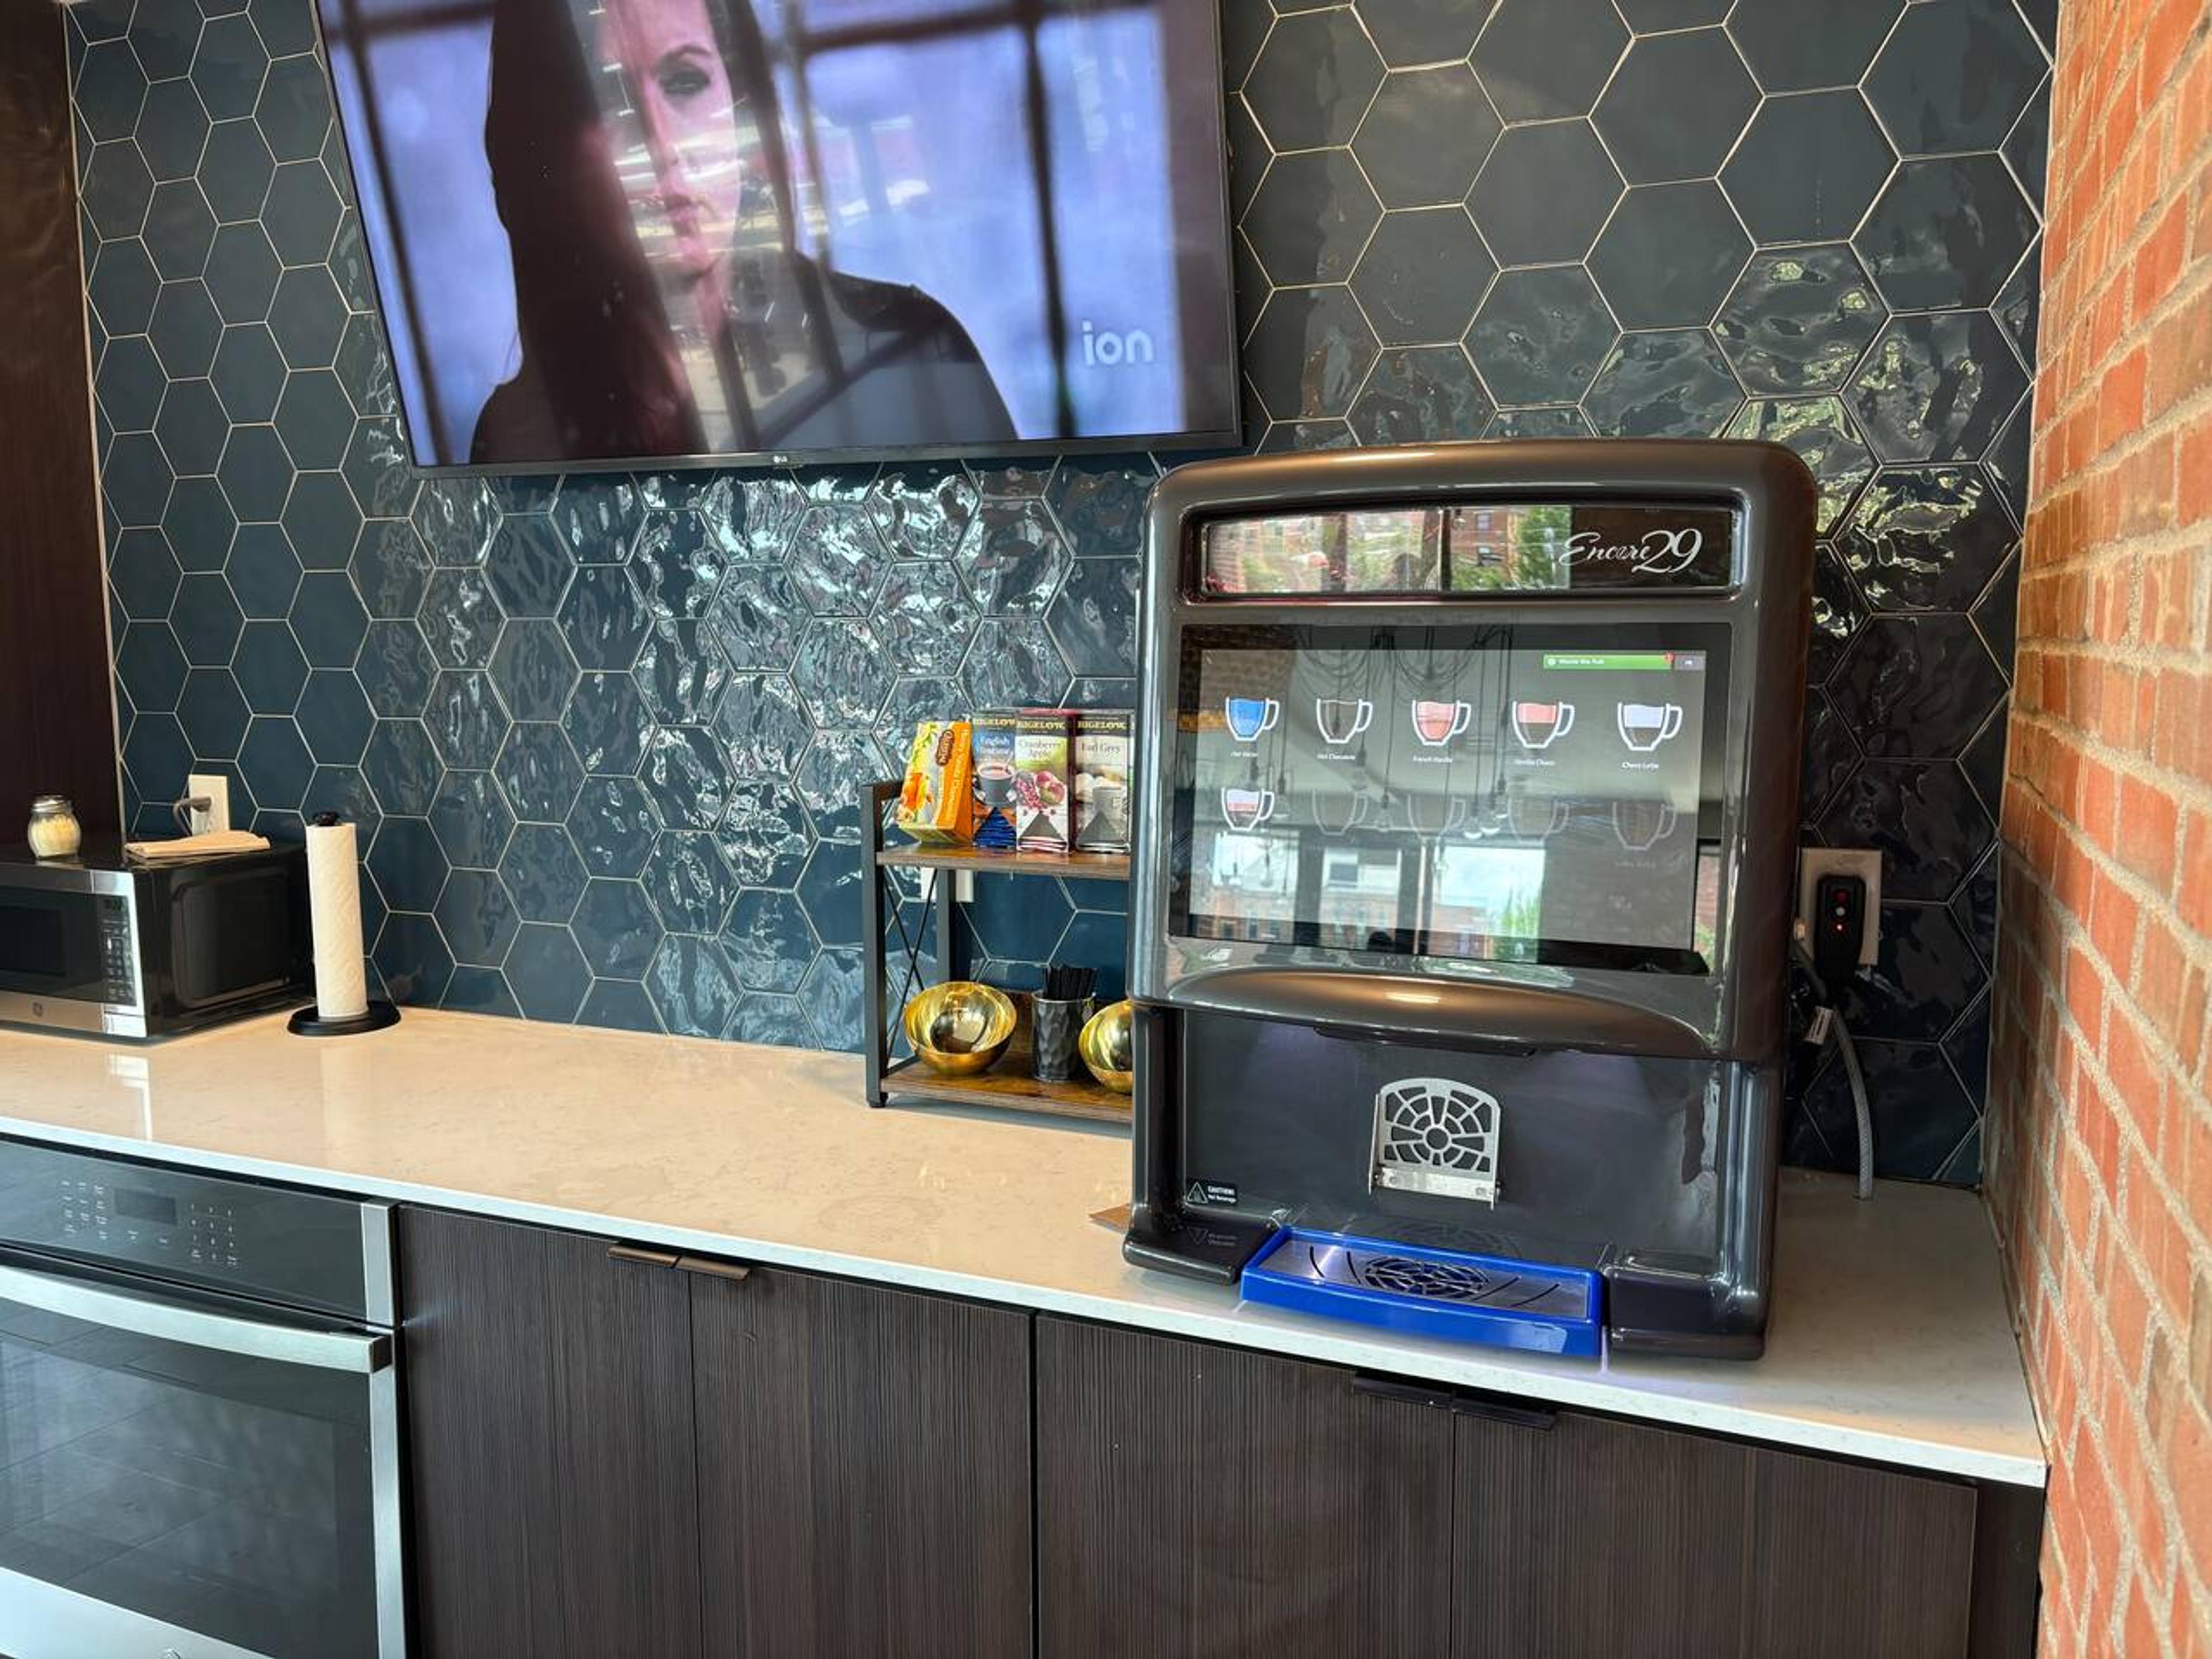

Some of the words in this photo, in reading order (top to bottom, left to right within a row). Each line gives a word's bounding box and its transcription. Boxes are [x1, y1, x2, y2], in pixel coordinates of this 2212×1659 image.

[1082, 320, 1153, 366] ion
[1631, 528, 1702, 573] 29
[1078, 720, 1126, 730] BIGELOW
